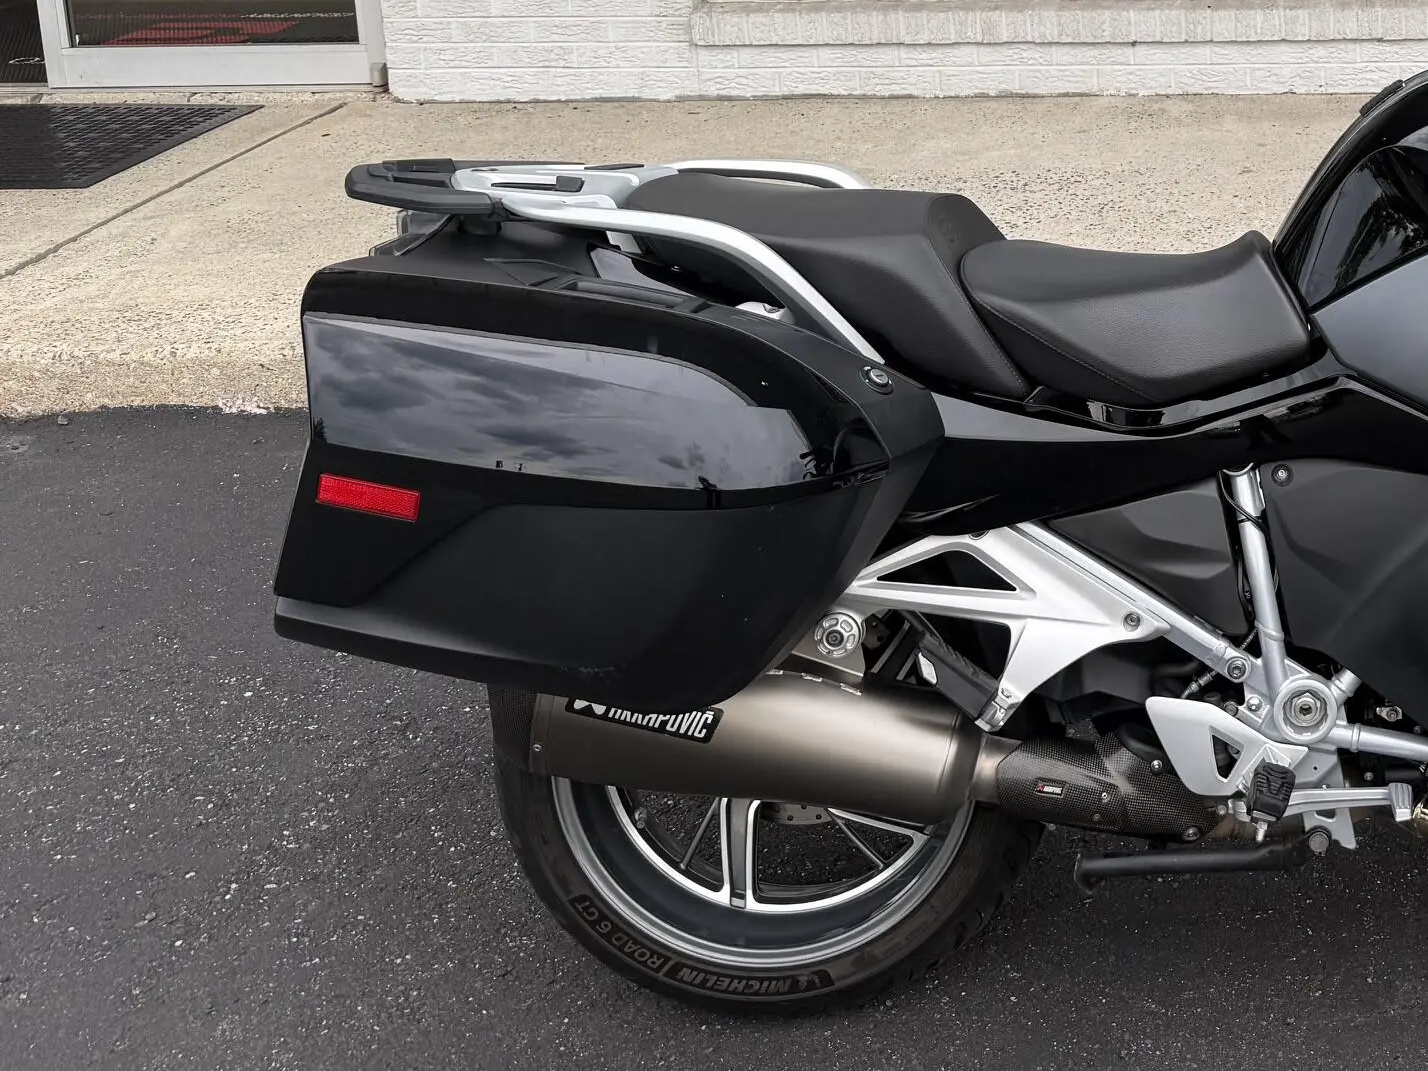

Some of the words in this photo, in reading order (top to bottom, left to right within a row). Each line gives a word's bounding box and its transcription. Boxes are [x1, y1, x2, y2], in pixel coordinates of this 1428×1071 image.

[576, 900, 599, 921] GT
[597, 920, 612, 932] 6
[611, 933, 666, 973] ROAD
[677, 967, 791, 995] MICHELIN
